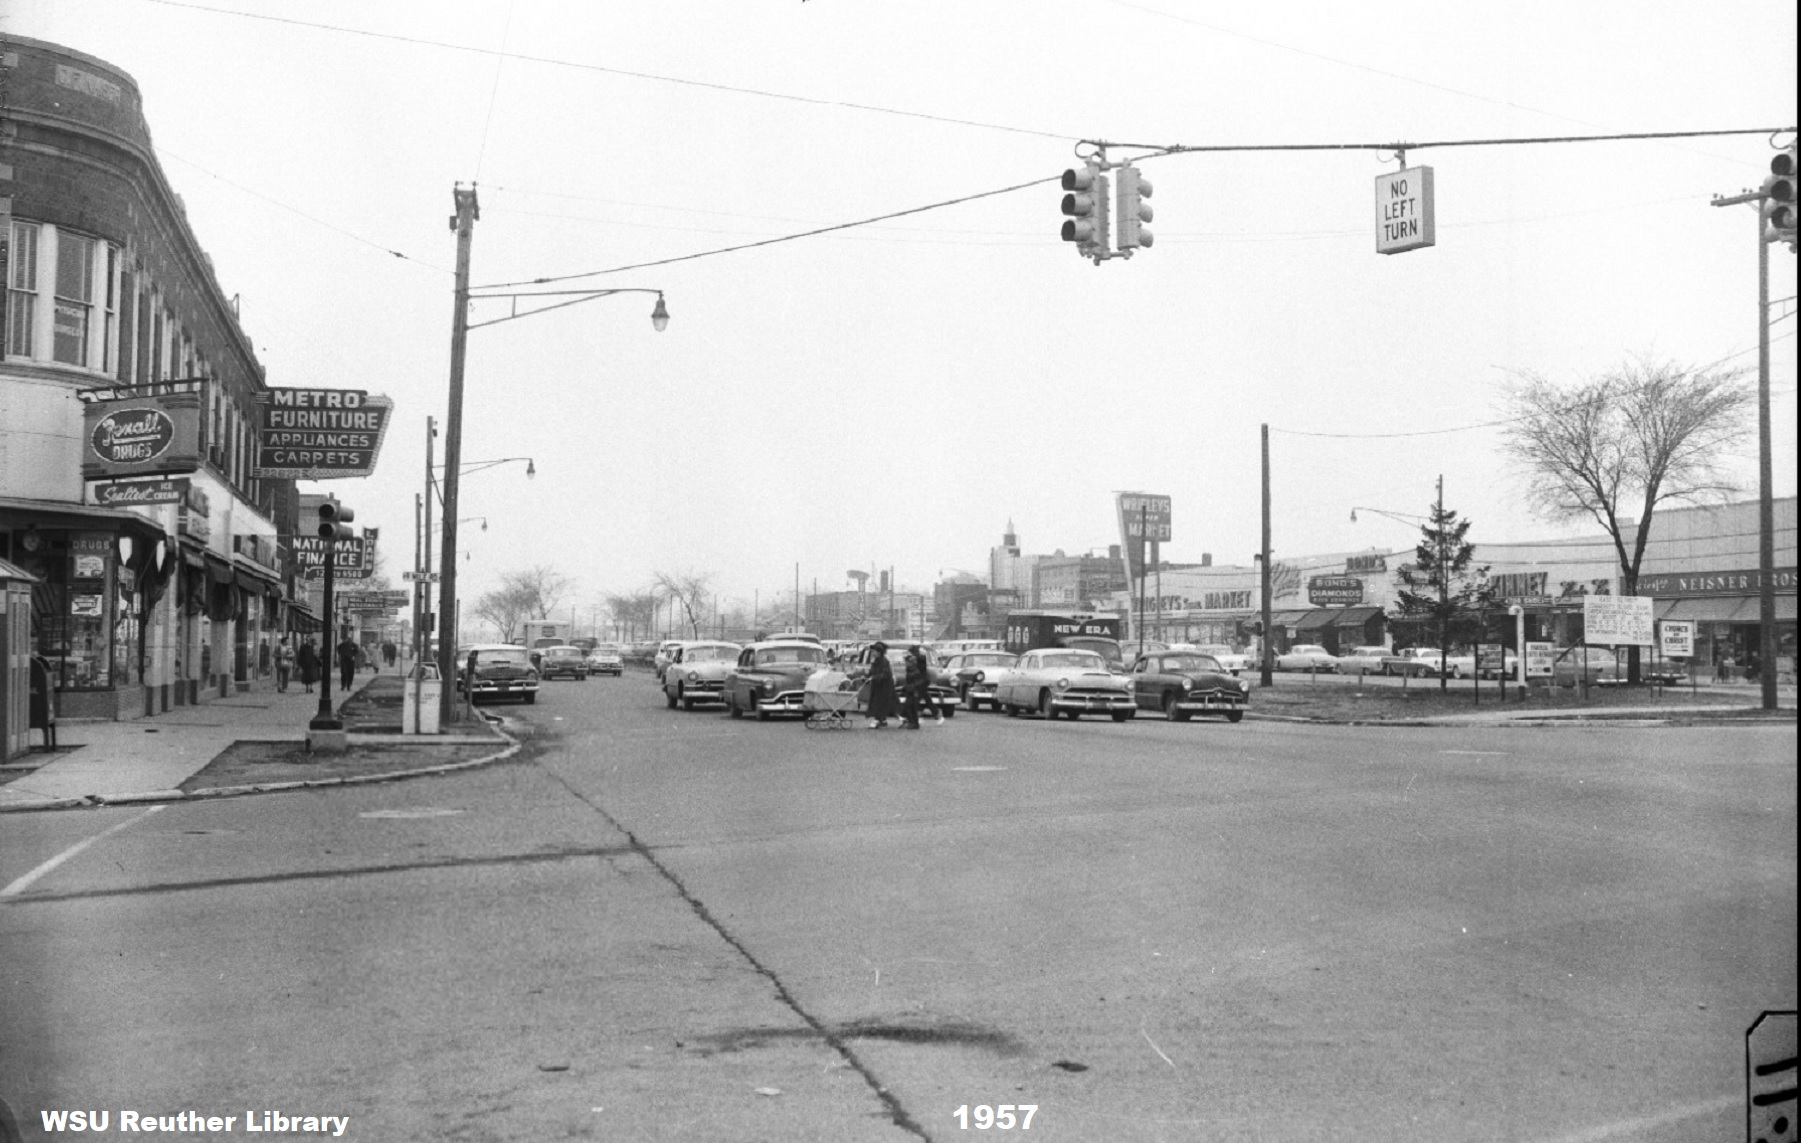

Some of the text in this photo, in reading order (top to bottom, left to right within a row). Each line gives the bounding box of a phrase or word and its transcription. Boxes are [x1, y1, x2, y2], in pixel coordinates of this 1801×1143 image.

[1391, 179, 1407, 199] NO
[1384, 198, 1415, 220] LEFT
[1384, 218, 1417, 241] TURN
[274, 390, 360, 408] METRO
[270, 410, 379, 429] FURNITURE
[269, 433, 369, 447] APPLIANCES
[113, 442, 152, 460] DRUGS
[273, 451, 360, 465] CARPETS
[161, 482, 173, 490] ICE
[153, 491, 179, 500] CREAM
[73, 541, 110, 549] DRUGS
[293, 537, 361, 552] NATINAL
[1679, 575, 1748, 591] NEISNER
[1205, 590, 1252, 609] MARKET
[1311, 589, 1361, 597] DIAMONDS
[1054, 624, 1111, 635] NEW ERA
